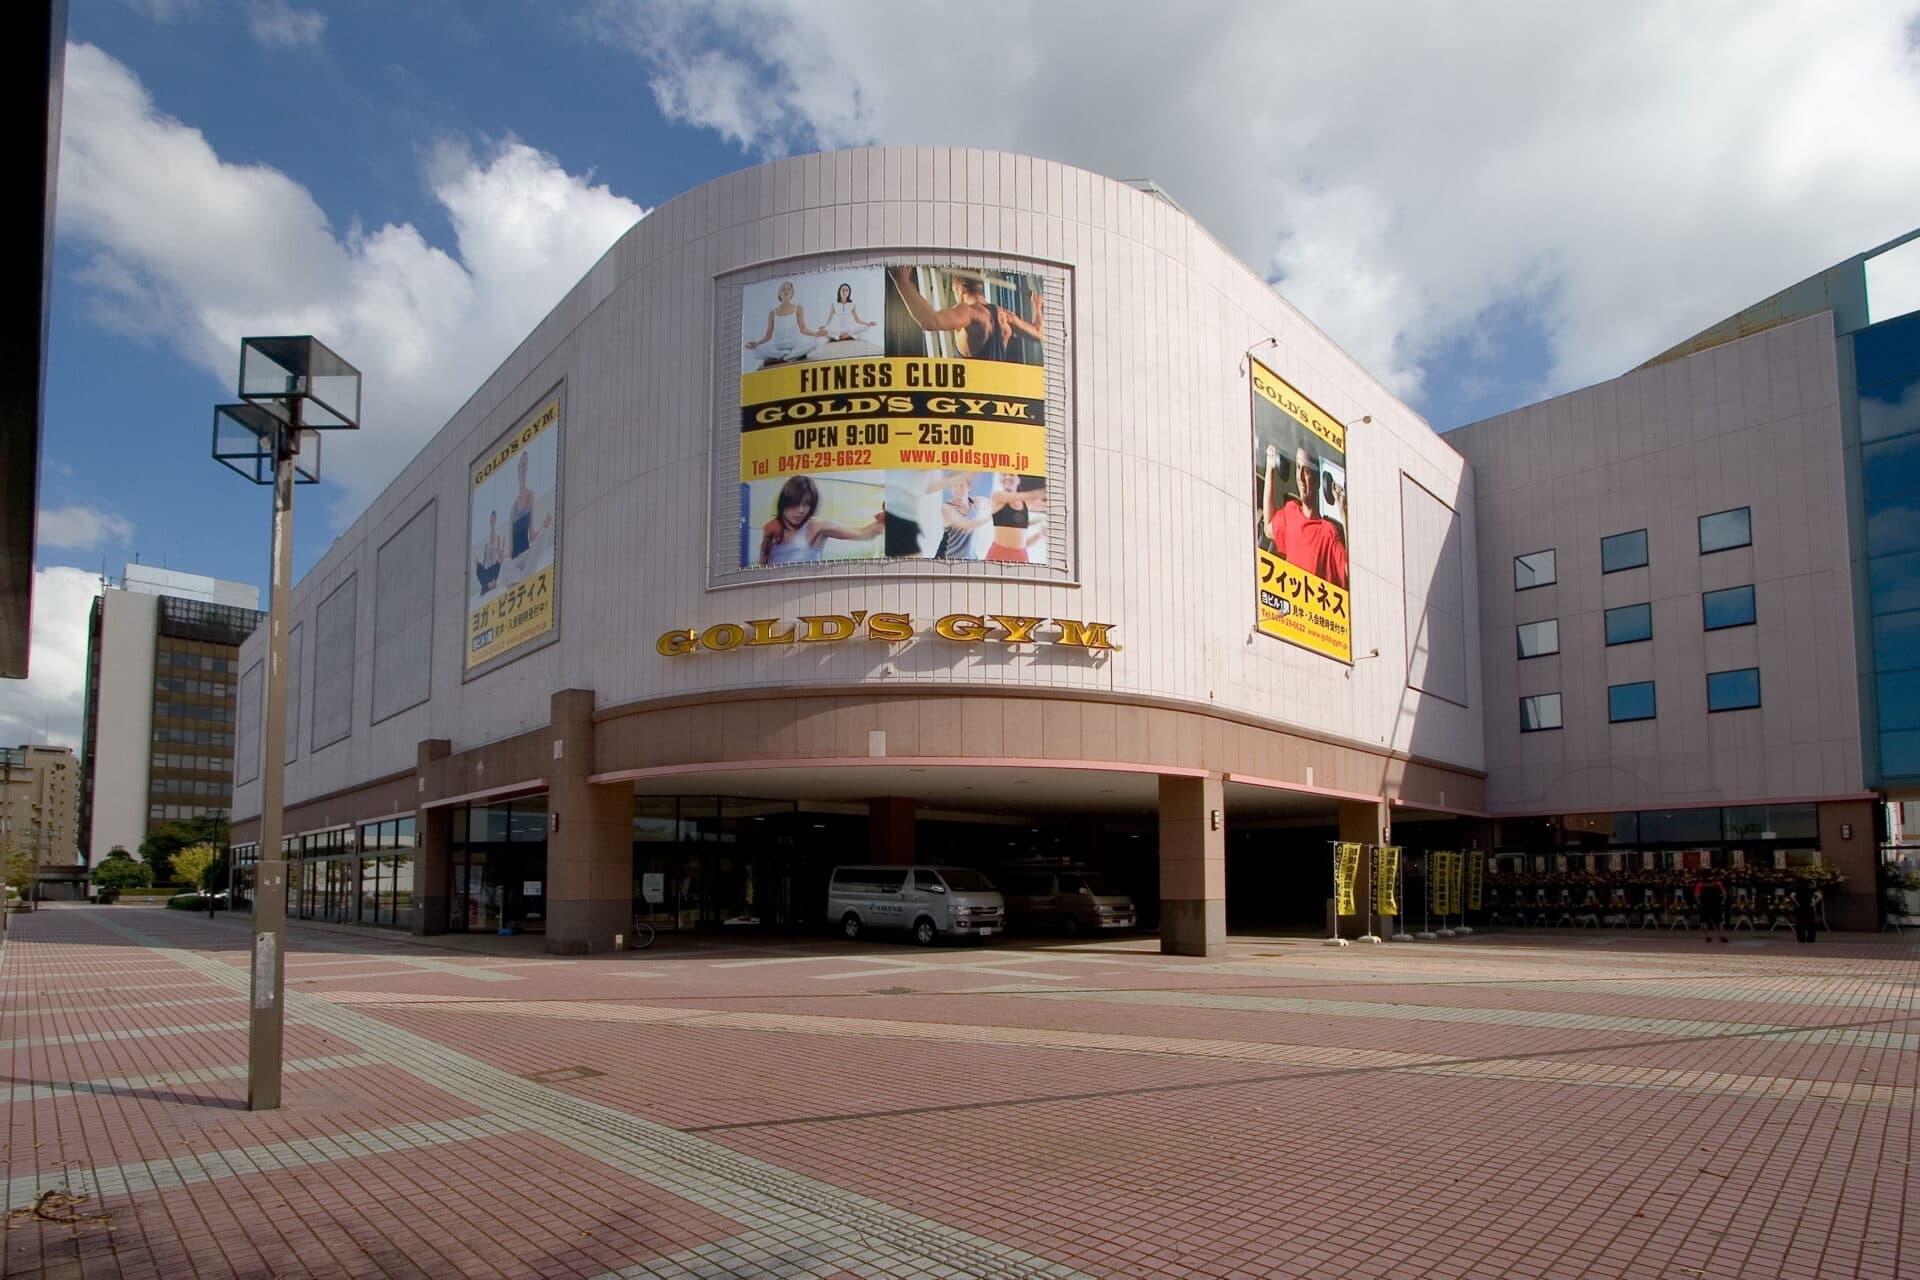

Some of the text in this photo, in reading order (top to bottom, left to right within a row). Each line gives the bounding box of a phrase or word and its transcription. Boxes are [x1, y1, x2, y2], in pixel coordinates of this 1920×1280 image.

[801, 362, 966, 393] FITNESS CLUB
[756, 395, 915, 424] GOLD'S
[1253, 377, 1343, 448] GOLD'S GYM
[475, 408, 554, 484] GOLD'S GYM
[794, 425, 838, 450] OPEN
[846, 424, 888, 446] 9:00
[919, 424, 974, 446] 25:00
[752, 449, 1029, 475] Tel 0476-29-6622 www.goldsgym.jp
[1261, 557, 1346, 618] フィットネス
[656, 610, 1118, 657] GOLD'S GYM
